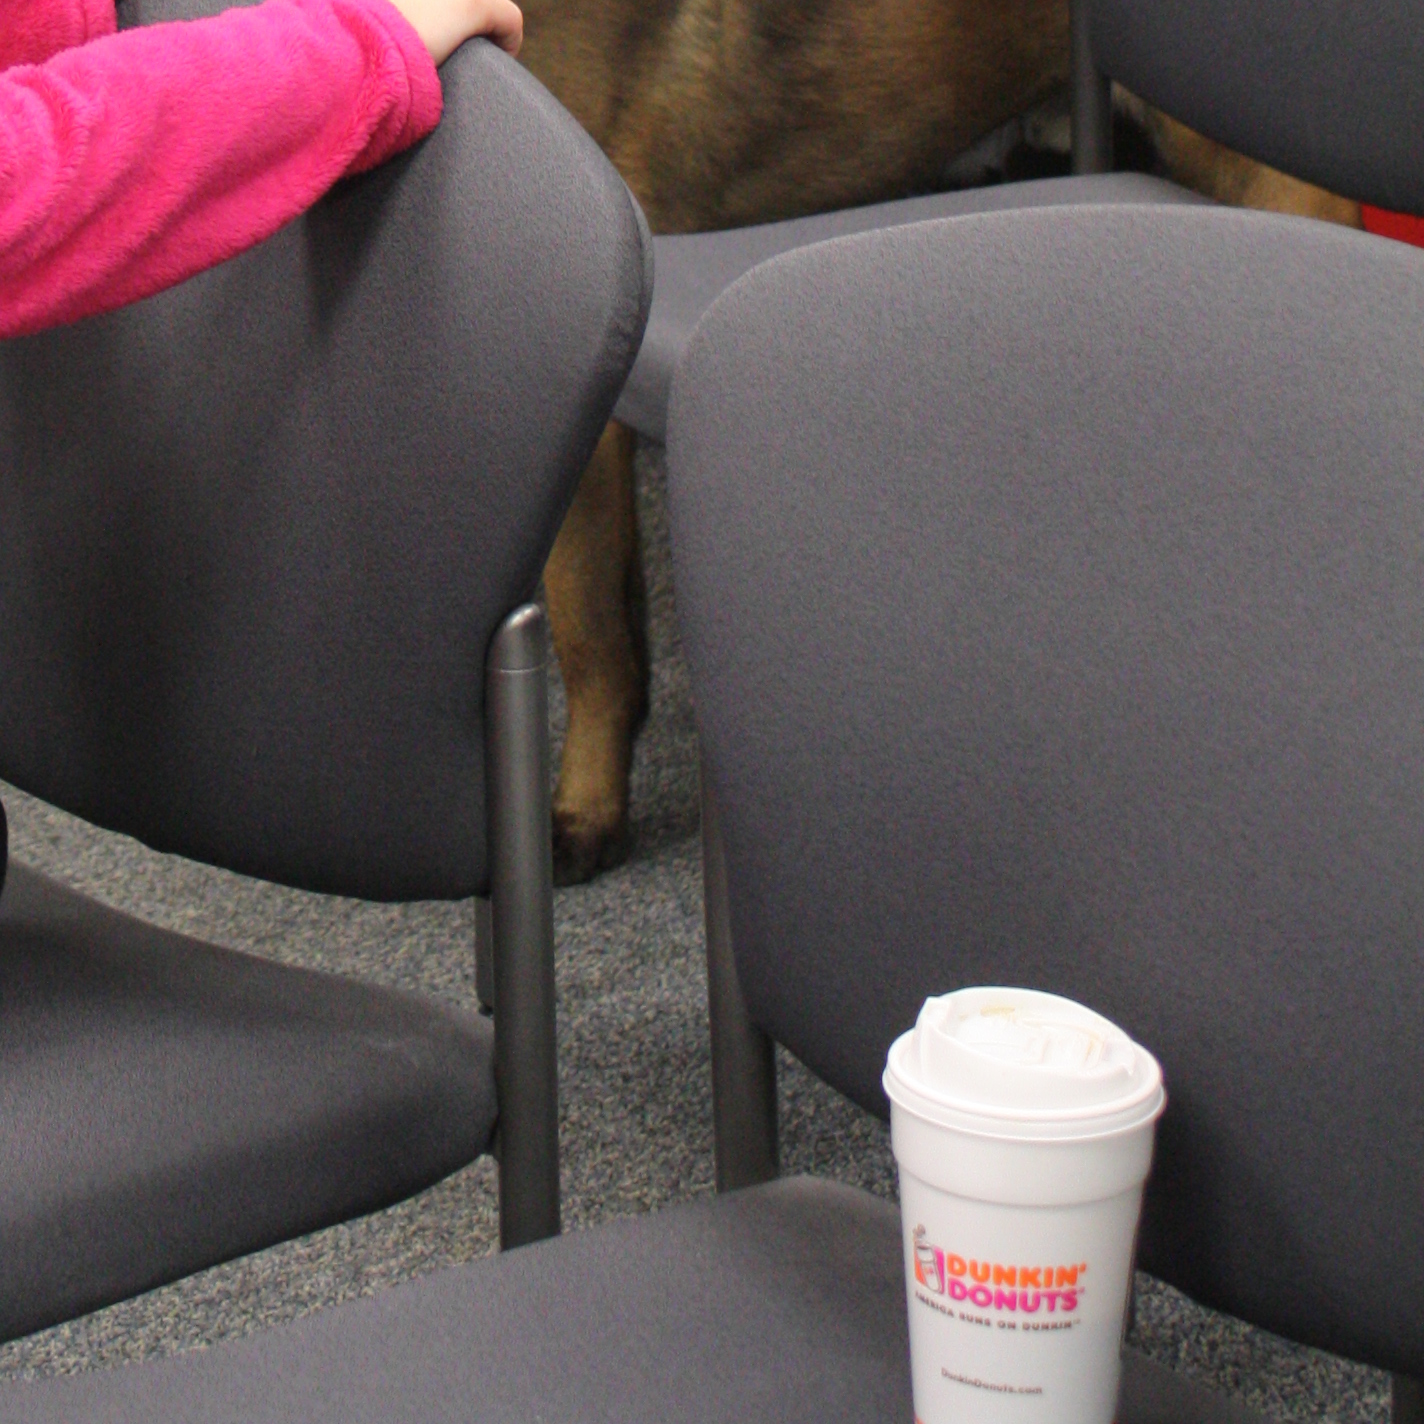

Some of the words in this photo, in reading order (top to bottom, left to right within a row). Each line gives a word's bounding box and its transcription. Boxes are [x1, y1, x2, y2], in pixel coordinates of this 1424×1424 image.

[947, 1252, 1088, 1289] DUNKIN'
[915, 1290, 954, 1319] AMERICA
[959, 1312, 992, 1328] RUNS
[997, 1319, 1017, 1331] ON
[947, 1278, 1080, 1313] DONUTS
[941, 1366, 1043, 1395] DunkinDonuts.com
